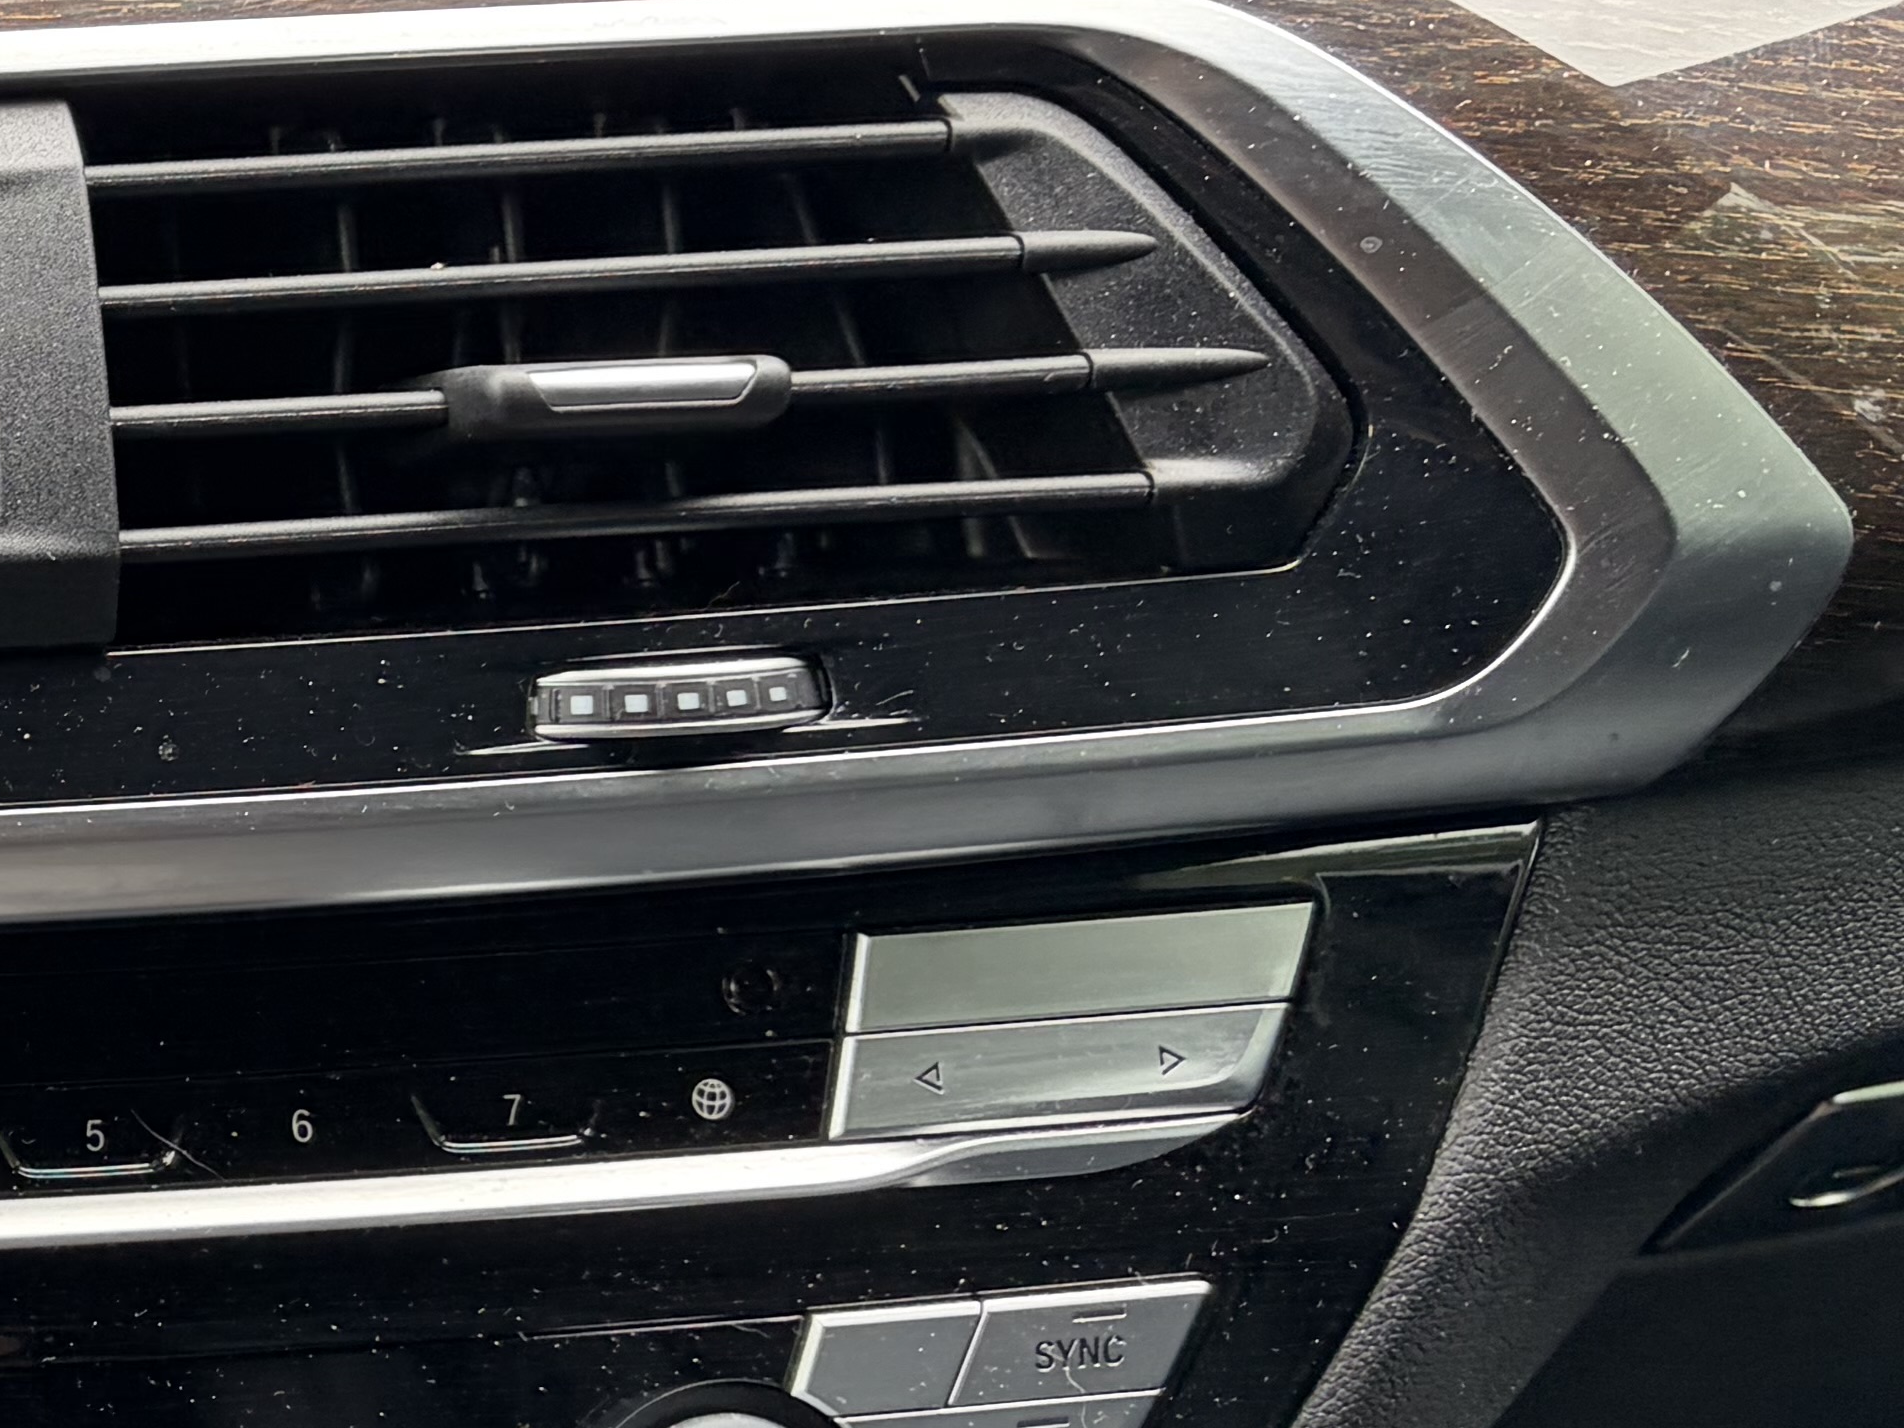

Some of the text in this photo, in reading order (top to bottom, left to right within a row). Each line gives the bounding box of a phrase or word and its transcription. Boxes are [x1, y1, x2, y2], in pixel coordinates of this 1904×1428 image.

[292, 1108, 314, 1144] 6
[502, 1093, 525, 1128] 7
[85, 1118, 107, 1152] 5
[1034, 1335, 1127, 1370] SYNC
